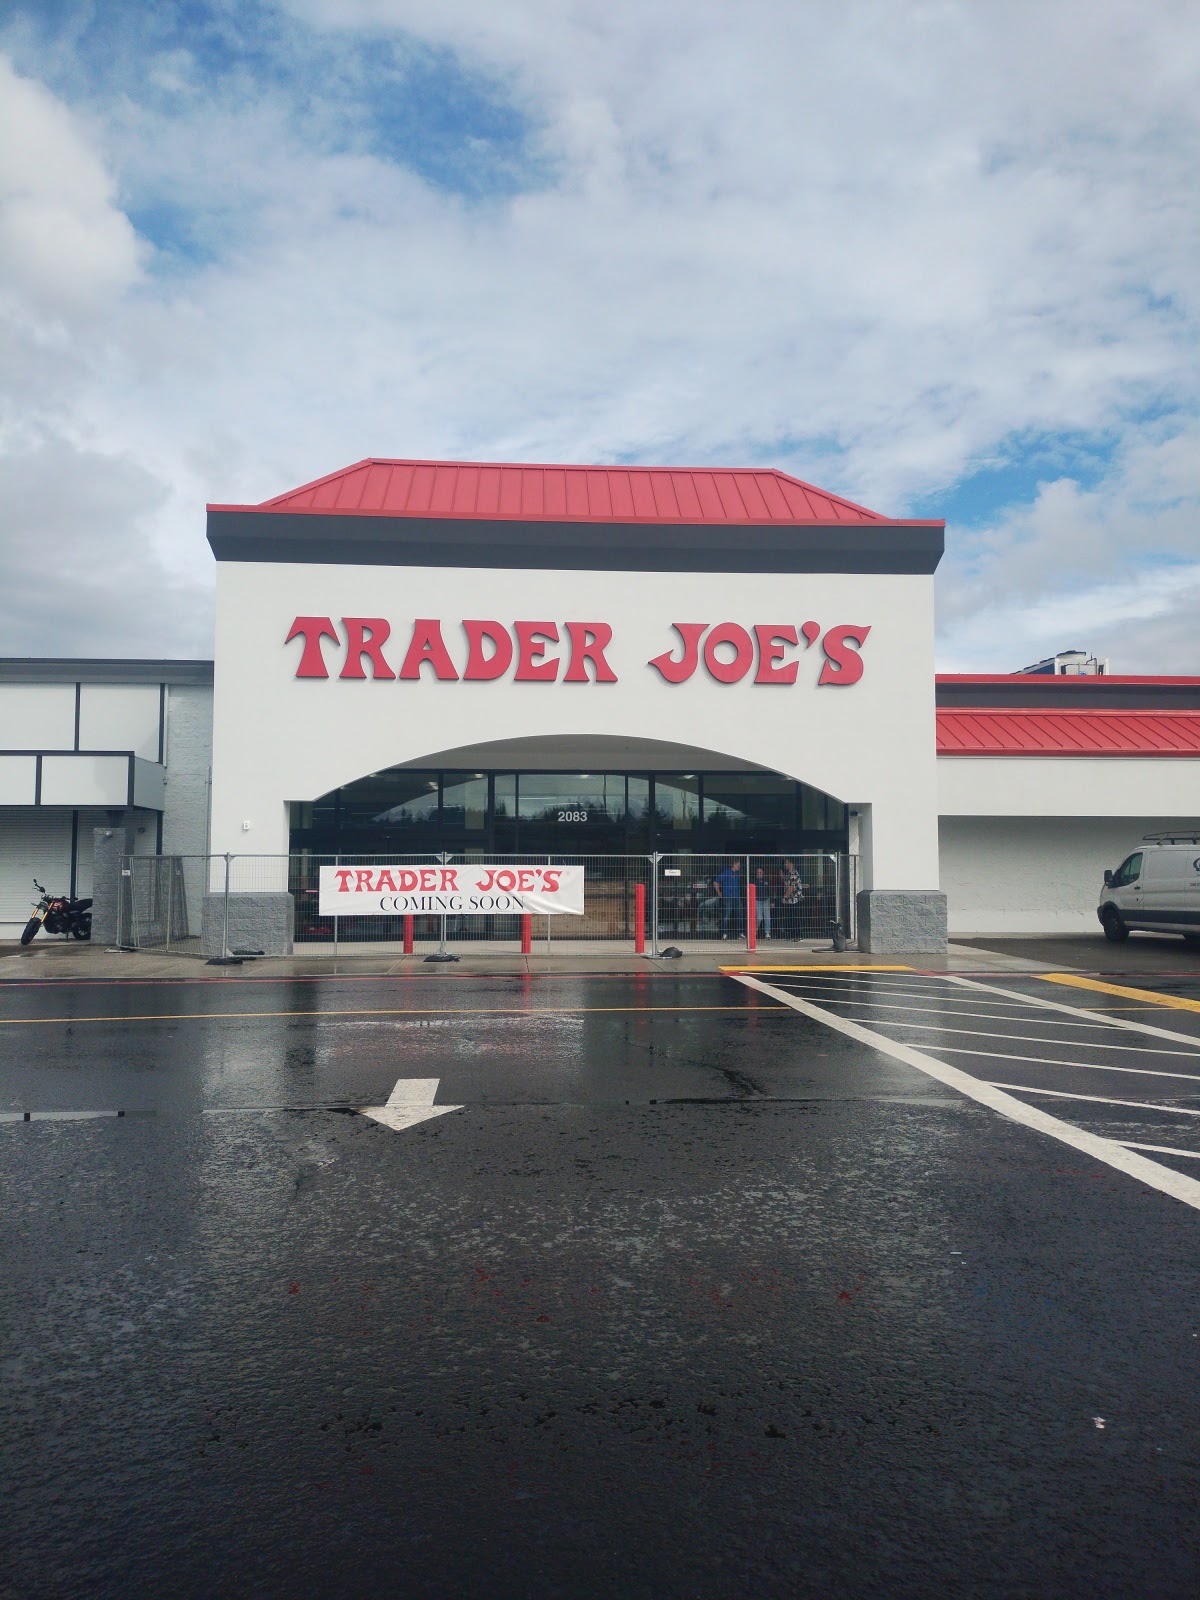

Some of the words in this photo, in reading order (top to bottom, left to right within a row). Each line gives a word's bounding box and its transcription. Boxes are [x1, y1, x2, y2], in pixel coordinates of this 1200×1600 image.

[285, 616, 618, 683] TRADER
[648, 620, 872, 686] JOE'S
[557, 811, 588, 822] 2083
[335, 869, 459, 892] TRADER
[475, 869, 562, 892] JOE'S
[379, 896, 463, 911] COMING
[468, 896, 525, 910] SOON
